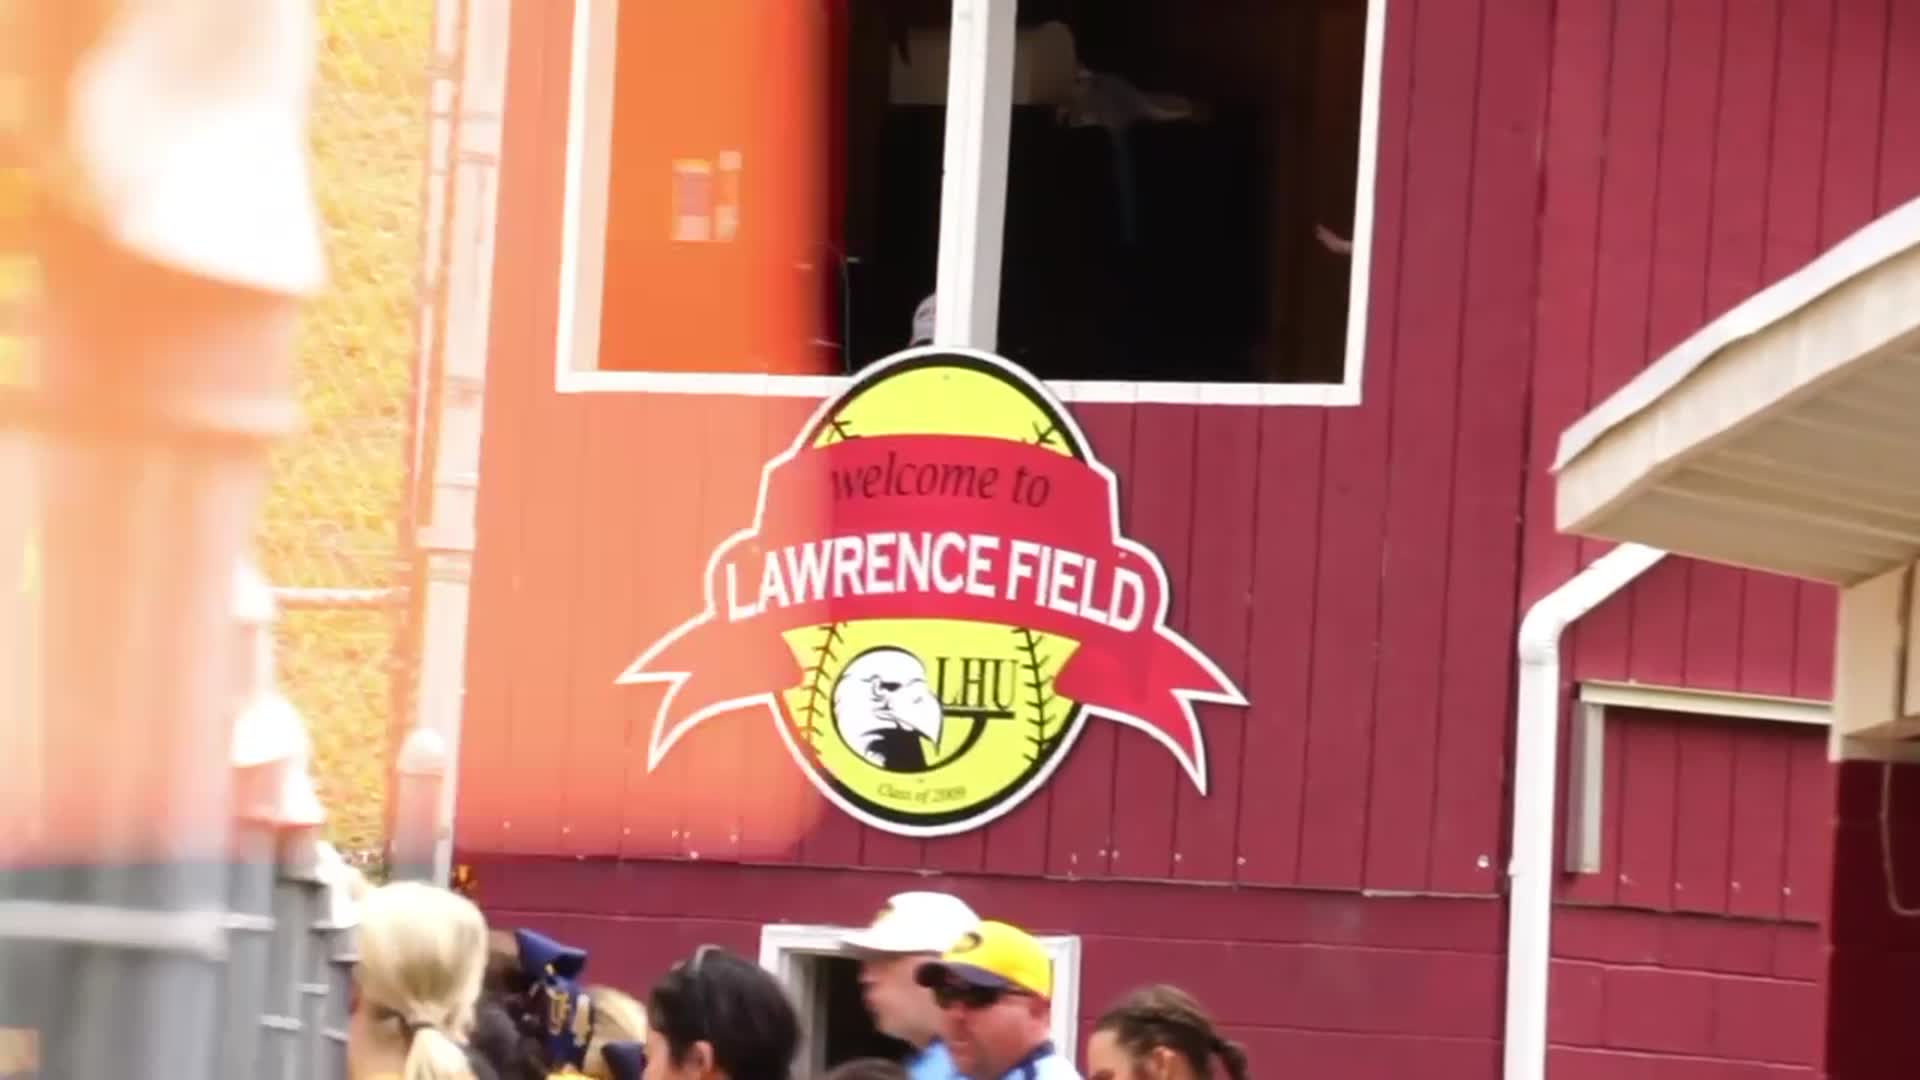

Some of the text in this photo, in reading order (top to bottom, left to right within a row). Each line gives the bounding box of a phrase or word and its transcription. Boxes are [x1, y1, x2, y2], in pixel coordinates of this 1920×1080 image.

[831, 451, 1051, 508] welcome to
[726, 531, 1146, 633] LAWRENCE FIELD
[936, 656, 1018, 711] LHU
